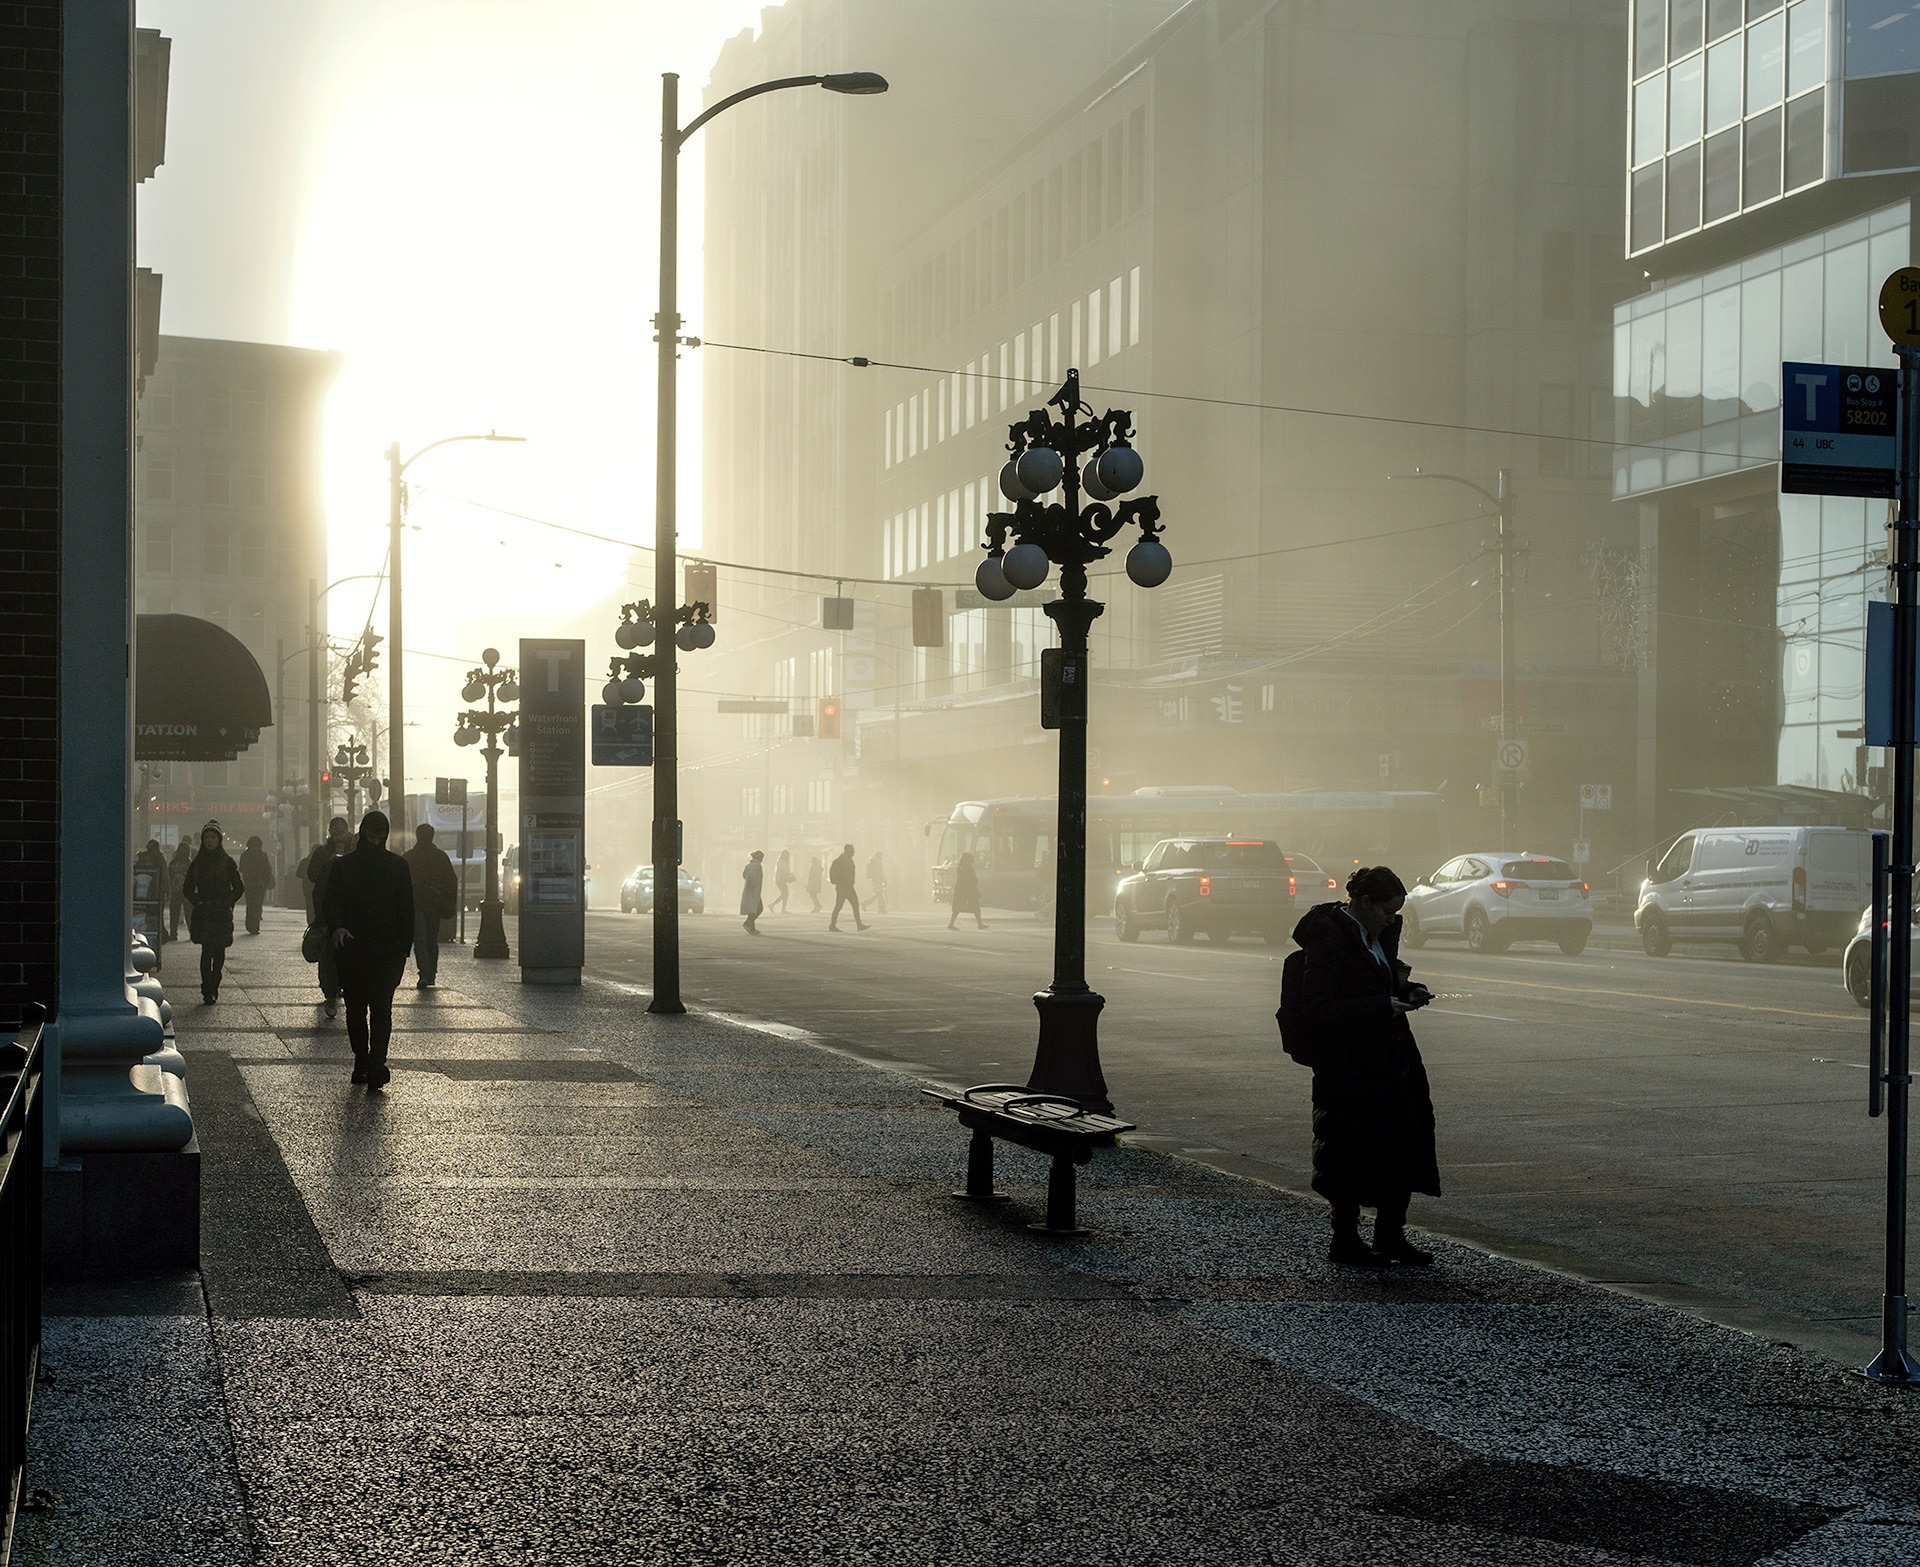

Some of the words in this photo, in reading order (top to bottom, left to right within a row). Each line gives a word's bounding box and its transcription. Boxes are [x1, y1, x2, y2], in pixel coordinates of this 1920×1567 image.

[1795, 373, 1828, 422] T
[1846, 397, 1860, 406] Bus
[1860, 397, 1878, 408] Stop
[1846, 409, 1887, 426] 58202
[1792, 438, 1805, 449] 44
[1816, 438, 1835, 450] UBC
[1034, 592, 1049, 604] St
[536, 649, 572, 692] T
[528, 713, 578, 723] Waterfront
[136, 724, 198, 736] TATION
[536, 725, 571, 734] Station
[210, 802, 275, 814] BREWIN
[438, 806, 474, 814] Gordn
